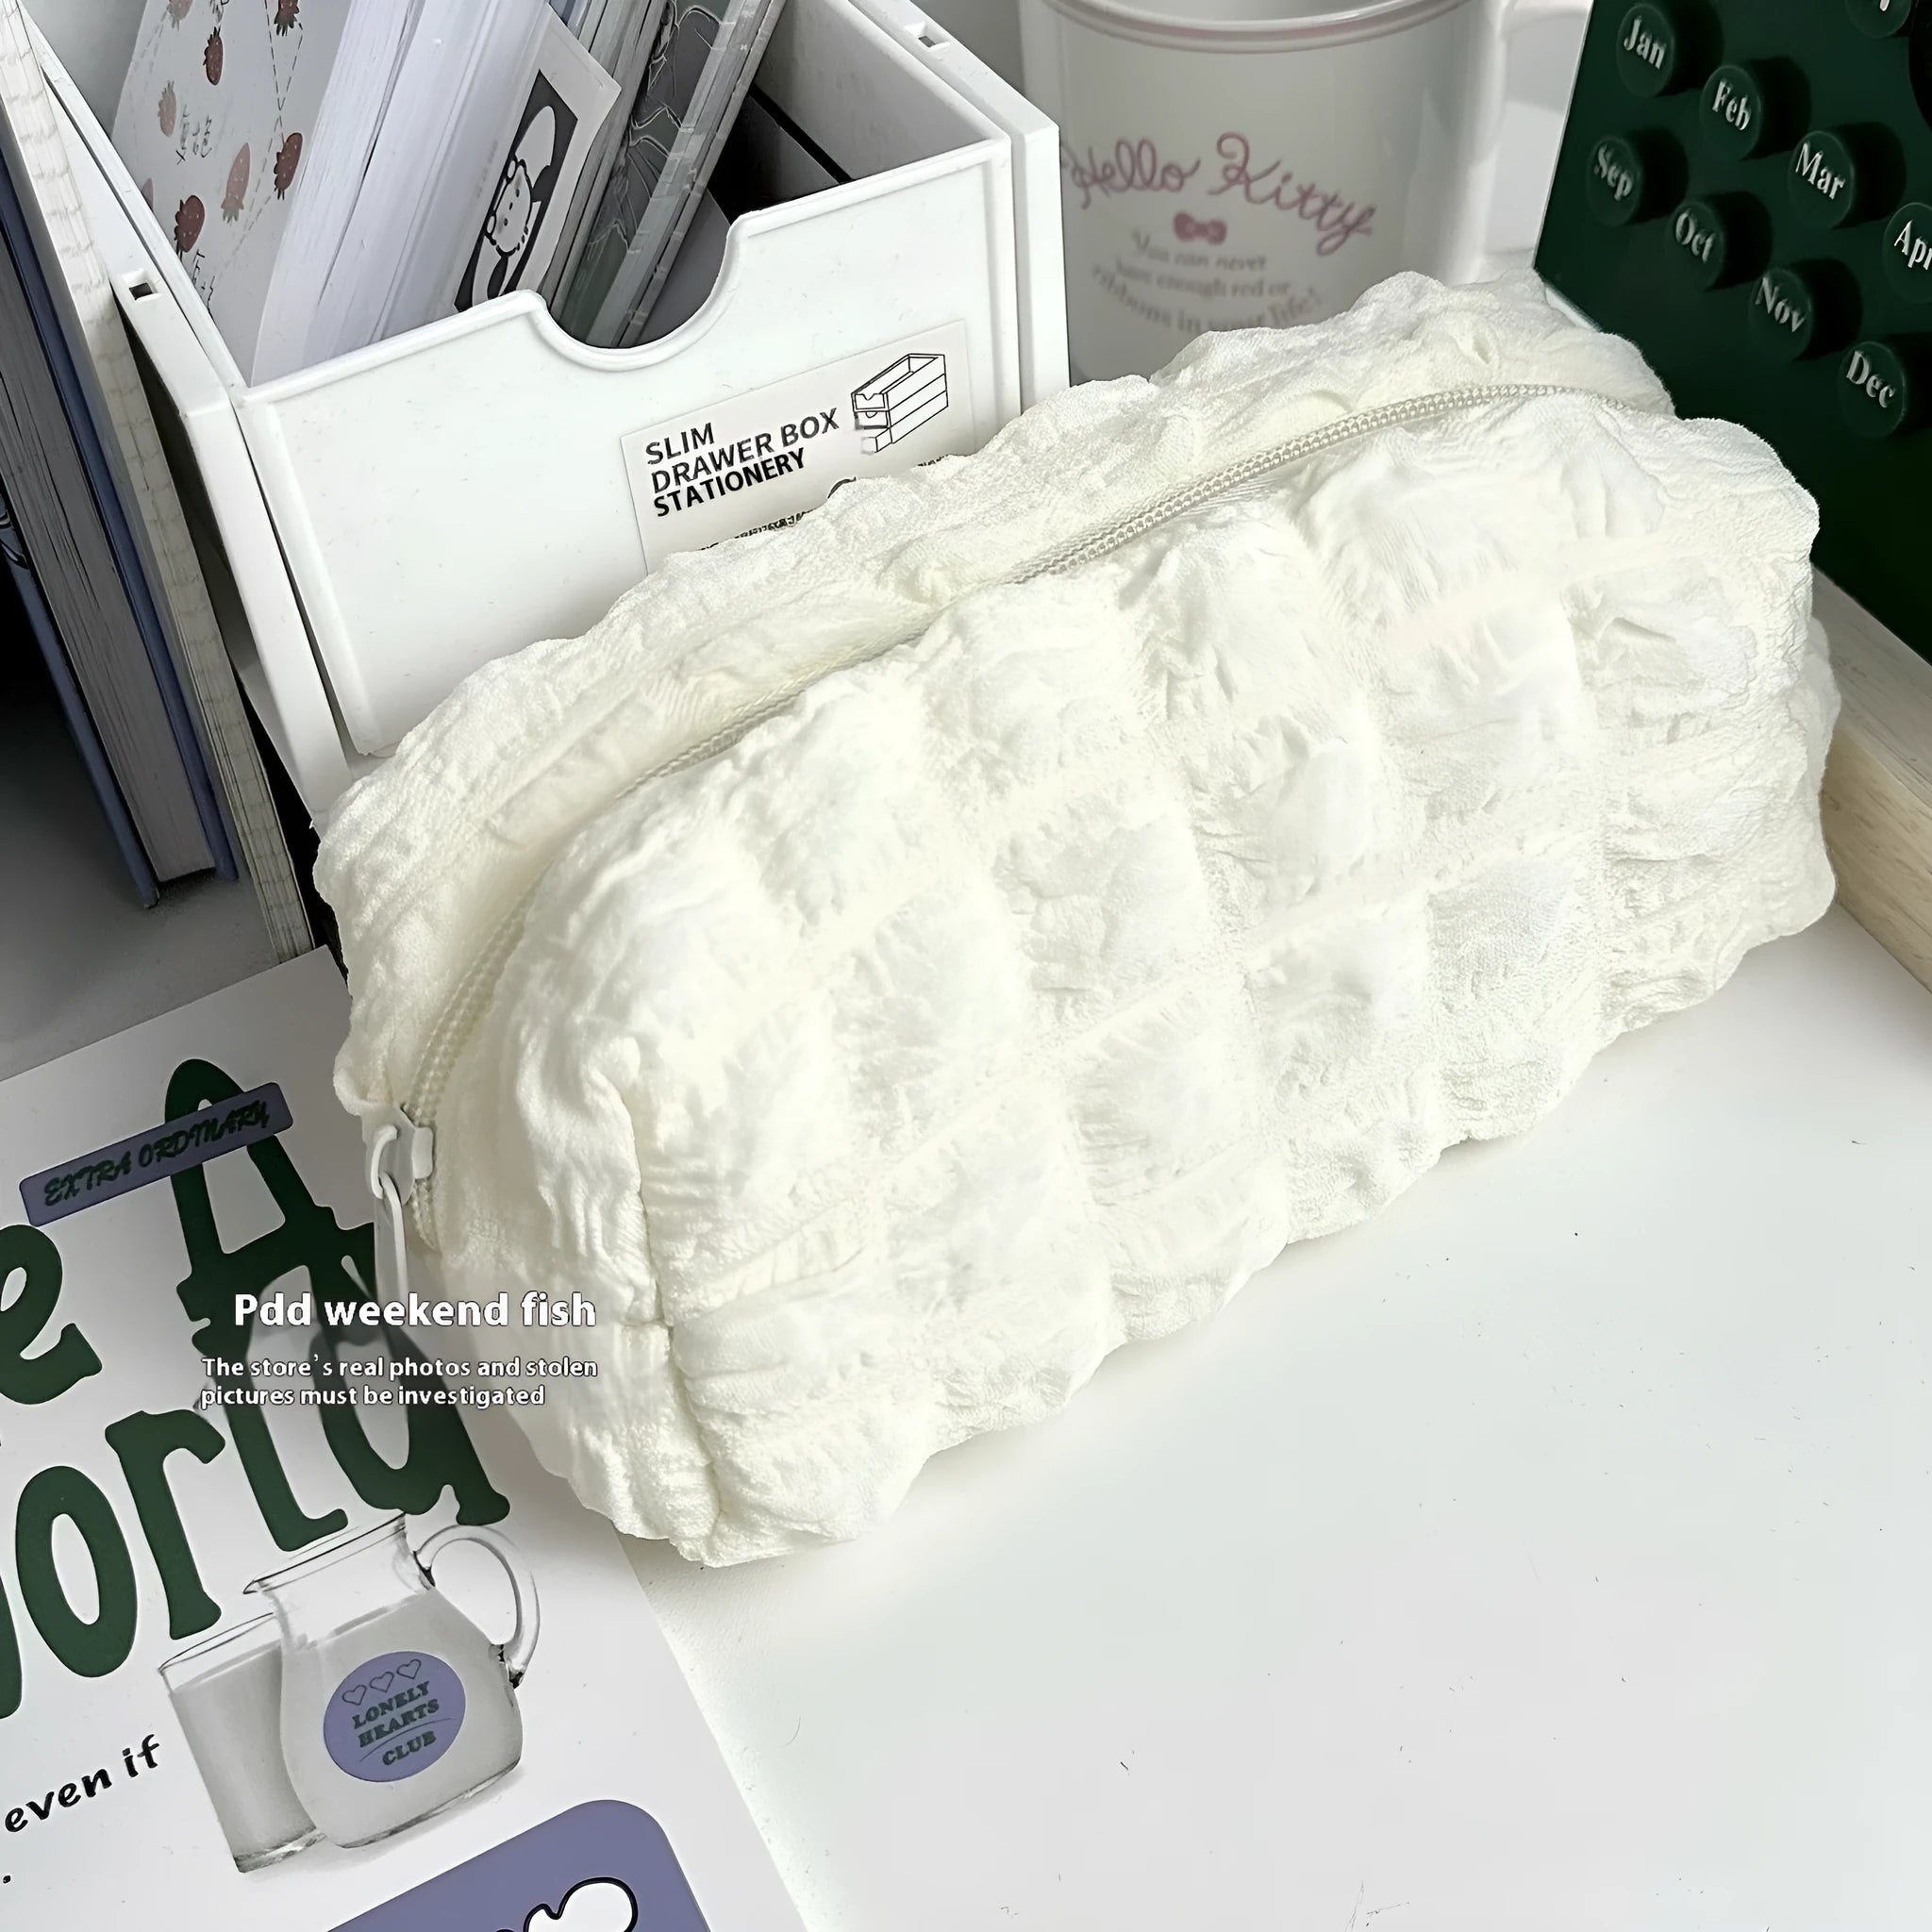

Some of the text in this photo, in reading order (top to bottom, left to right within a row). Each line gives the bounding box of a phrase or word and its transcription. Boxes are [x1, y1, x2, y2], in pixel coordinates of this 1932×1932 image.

[1624, 15, 1666, 69] Jan
[1712, 78, 1752, 130] Feb
[1061, 131, 1376, 257] Hello Kitty
[1593, 144, 1633, 201] Sep
[1795, 141, 1845, 200] Mar
[1674, 208, 1715, 263] Oct
[1755, 275, 1806, 333] Nov
[1845, 350, 1897, 408] Dec
[644, 422, 715, 465] SLIM
[650, 407, 841, 493] DRAWER BOX
[653, 447, 806, 517] STATIONERY
[43, 1151, 132, 1207] EXTRA
[352, 1681, 430, 1729] LONELY
[358, 1699, 440, 1748] HEARTS
[382, 1730, 438, 1766] CLUB
[5, 1734, 160, 1833] even if
